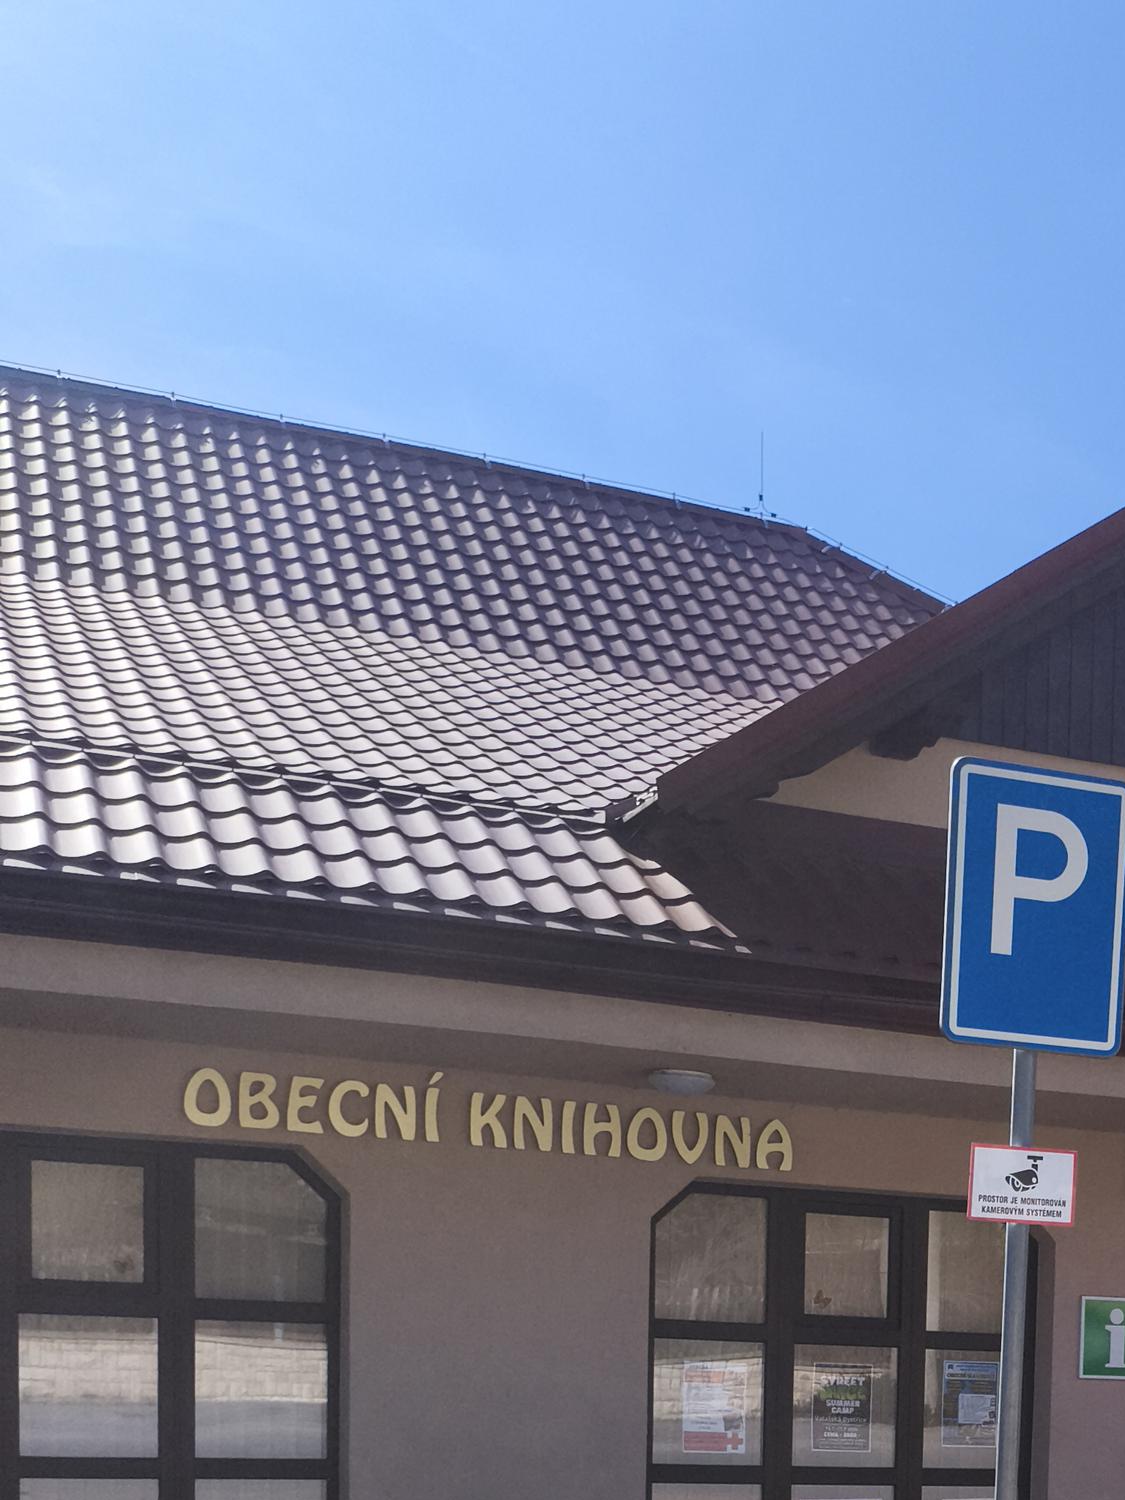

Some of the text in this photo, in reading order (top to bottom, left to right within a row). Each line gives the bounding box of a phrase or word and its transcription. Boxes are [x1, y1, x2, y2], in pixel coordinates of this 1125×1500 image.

[991, 803, 1088, 955] P
[183, 1067, 793, 1171] OBECNÍ KNIHOVNA
[978, 1194, 1008, 1204] PROSTOR
[1010, 1196, 1018, 1204] JE
[981, 1205, 1062, 1218] KAMEROVÝM SYSTÉMEM
